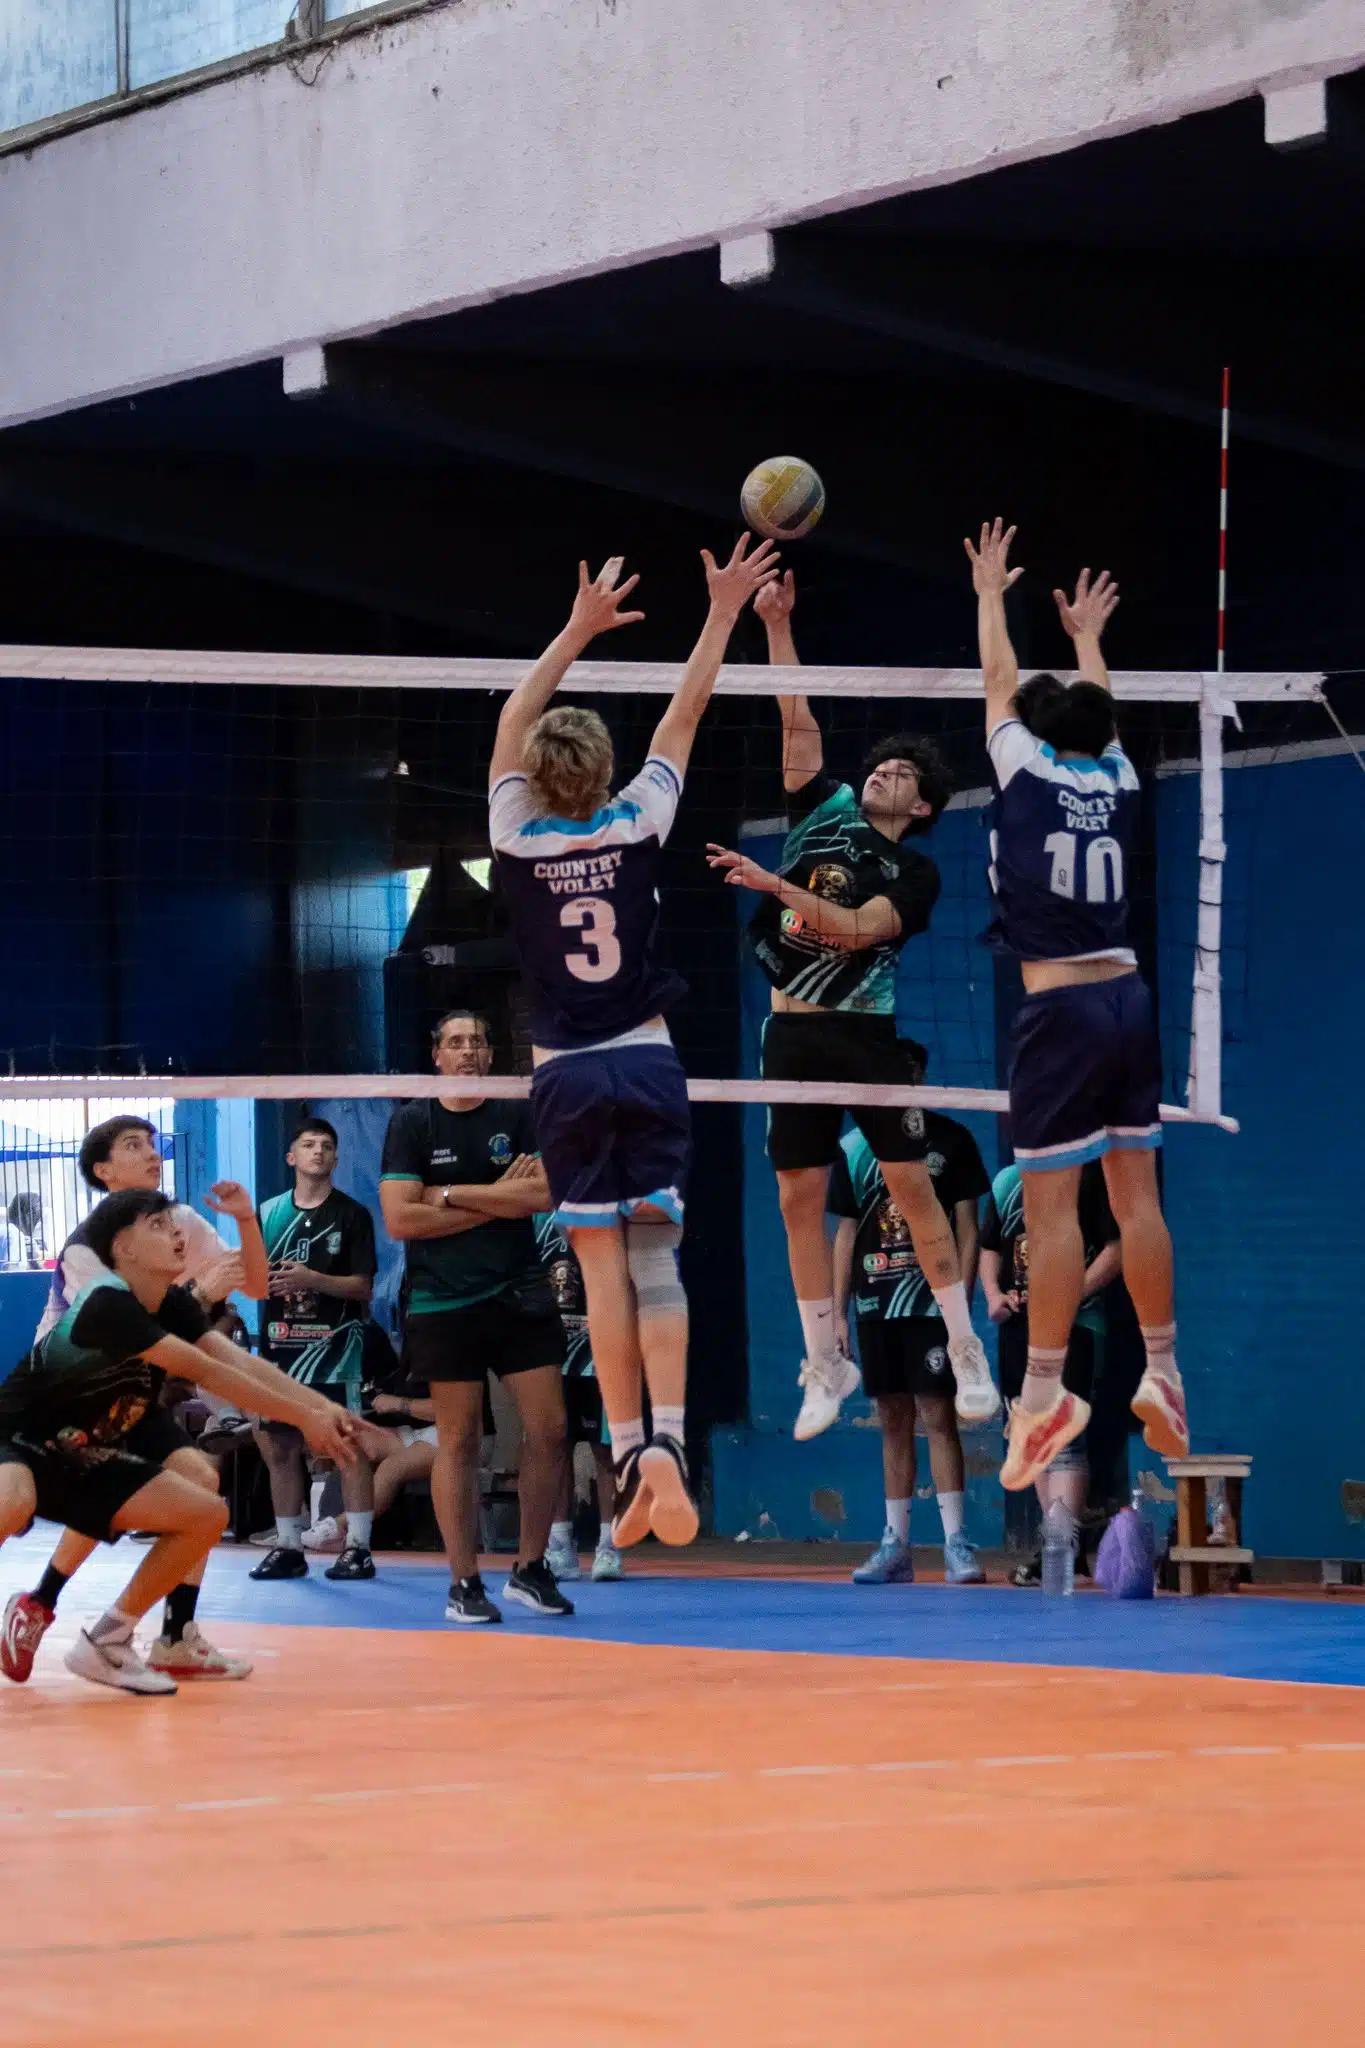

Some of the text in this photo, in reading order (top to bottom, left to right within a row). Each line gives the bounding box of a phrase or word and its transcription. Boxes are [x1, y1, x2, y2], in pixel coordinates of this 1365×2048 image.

[535, 851, 622, 878] COUNTRY
[549, 872, 615, 894] VOLEY
[1044, 831, 1123, 903] 10
[560, 897, 621, 982] 3
